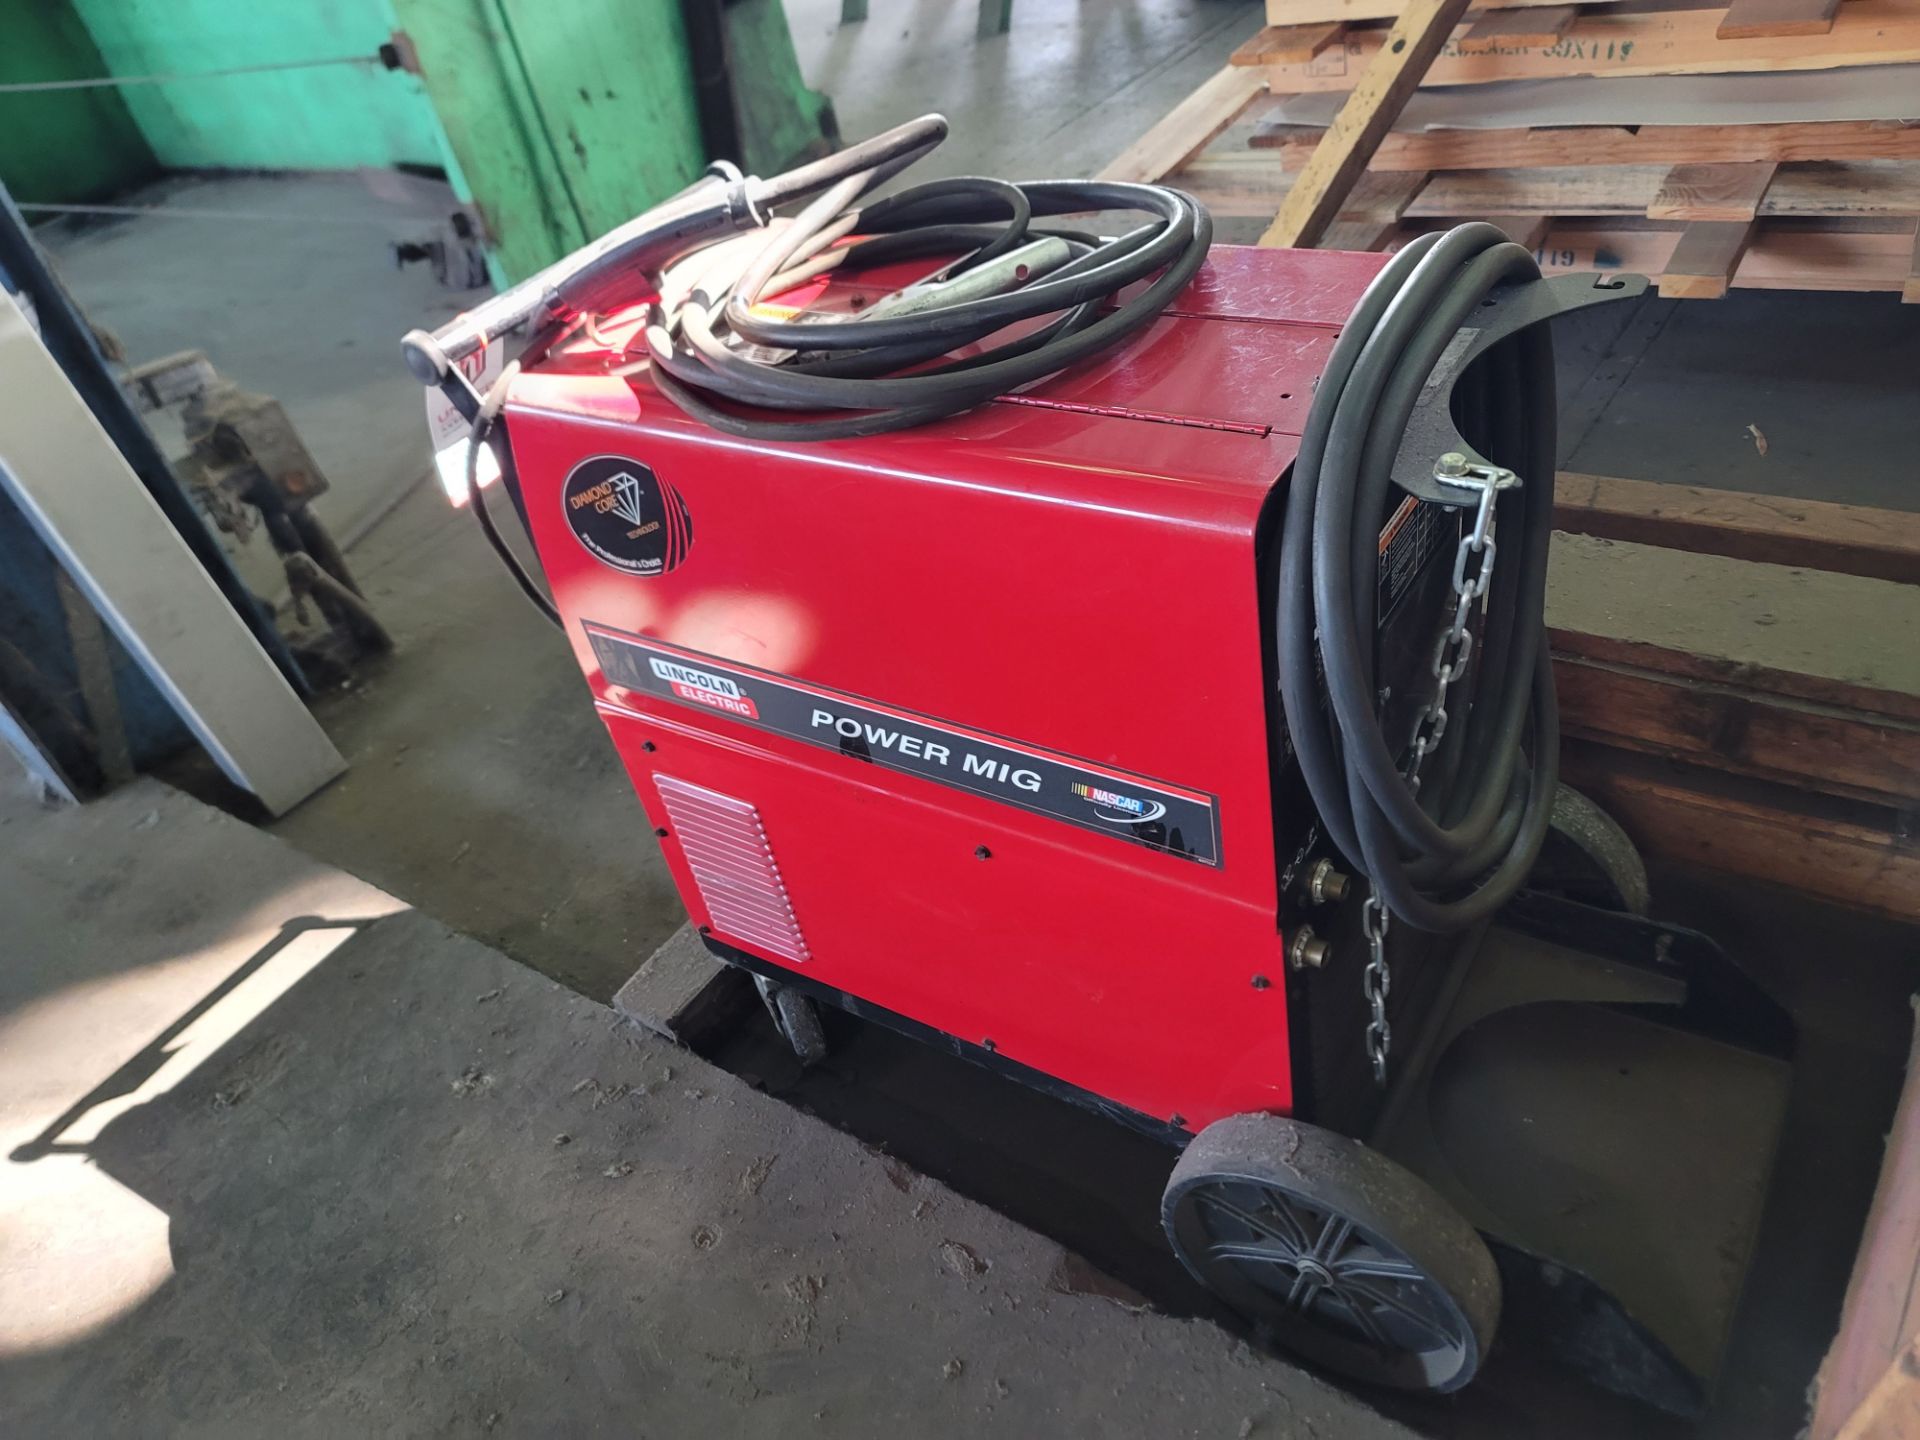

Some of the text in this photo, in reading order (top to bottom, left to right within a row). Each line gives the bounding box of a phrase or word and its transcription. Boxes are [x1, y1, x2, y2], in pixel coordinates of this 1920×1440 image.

[570, 481, 612, 510] DIAMOND
[595, 494, 619, 514] CORE
[653, 660, 736, 697] LINCOLN
[680, 686, 751, 716] ELECTRIC
[811, 708, 1043, 793] POWER MIG
[1092, 787, 1140, 812] NASCAR
